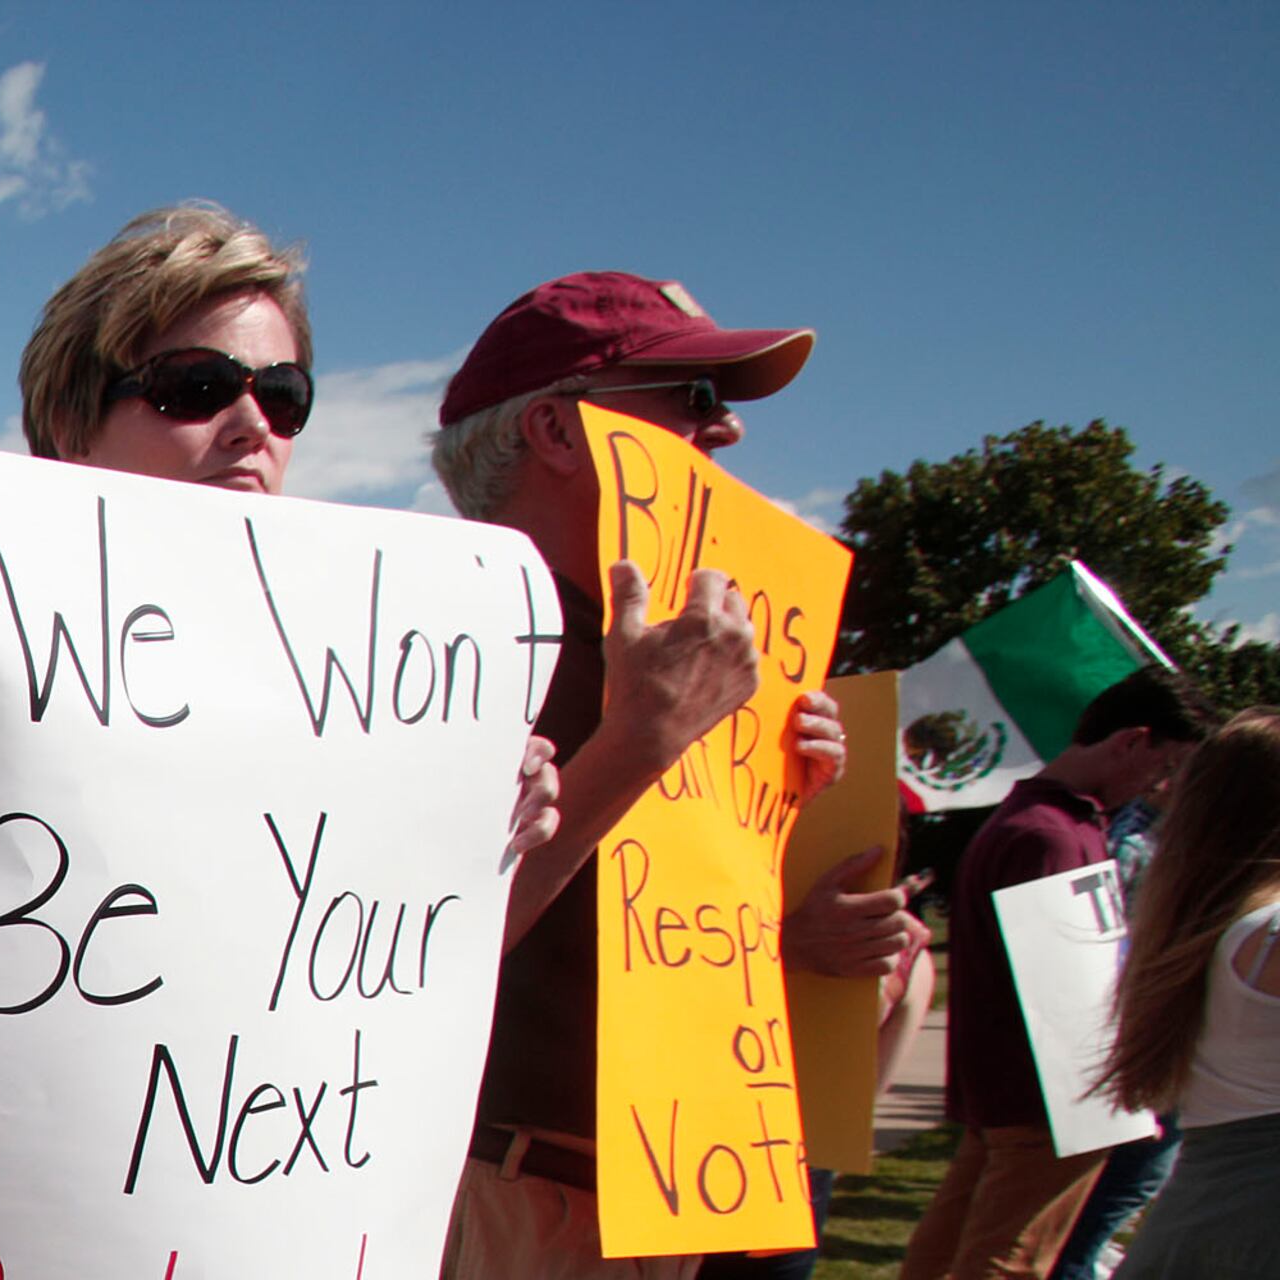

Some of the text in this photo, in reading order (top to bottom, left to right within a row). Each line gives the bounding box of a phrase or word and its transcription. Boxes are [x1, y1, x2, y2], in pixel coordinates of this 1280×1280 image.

[245, 517, 564, 738] Won't
[607, 430, 806, 684] Billns
[264, 812, 462, 1012] Your
[124, 1029, 379, 1197] Next
[732, 1017, 783, 1073] or
